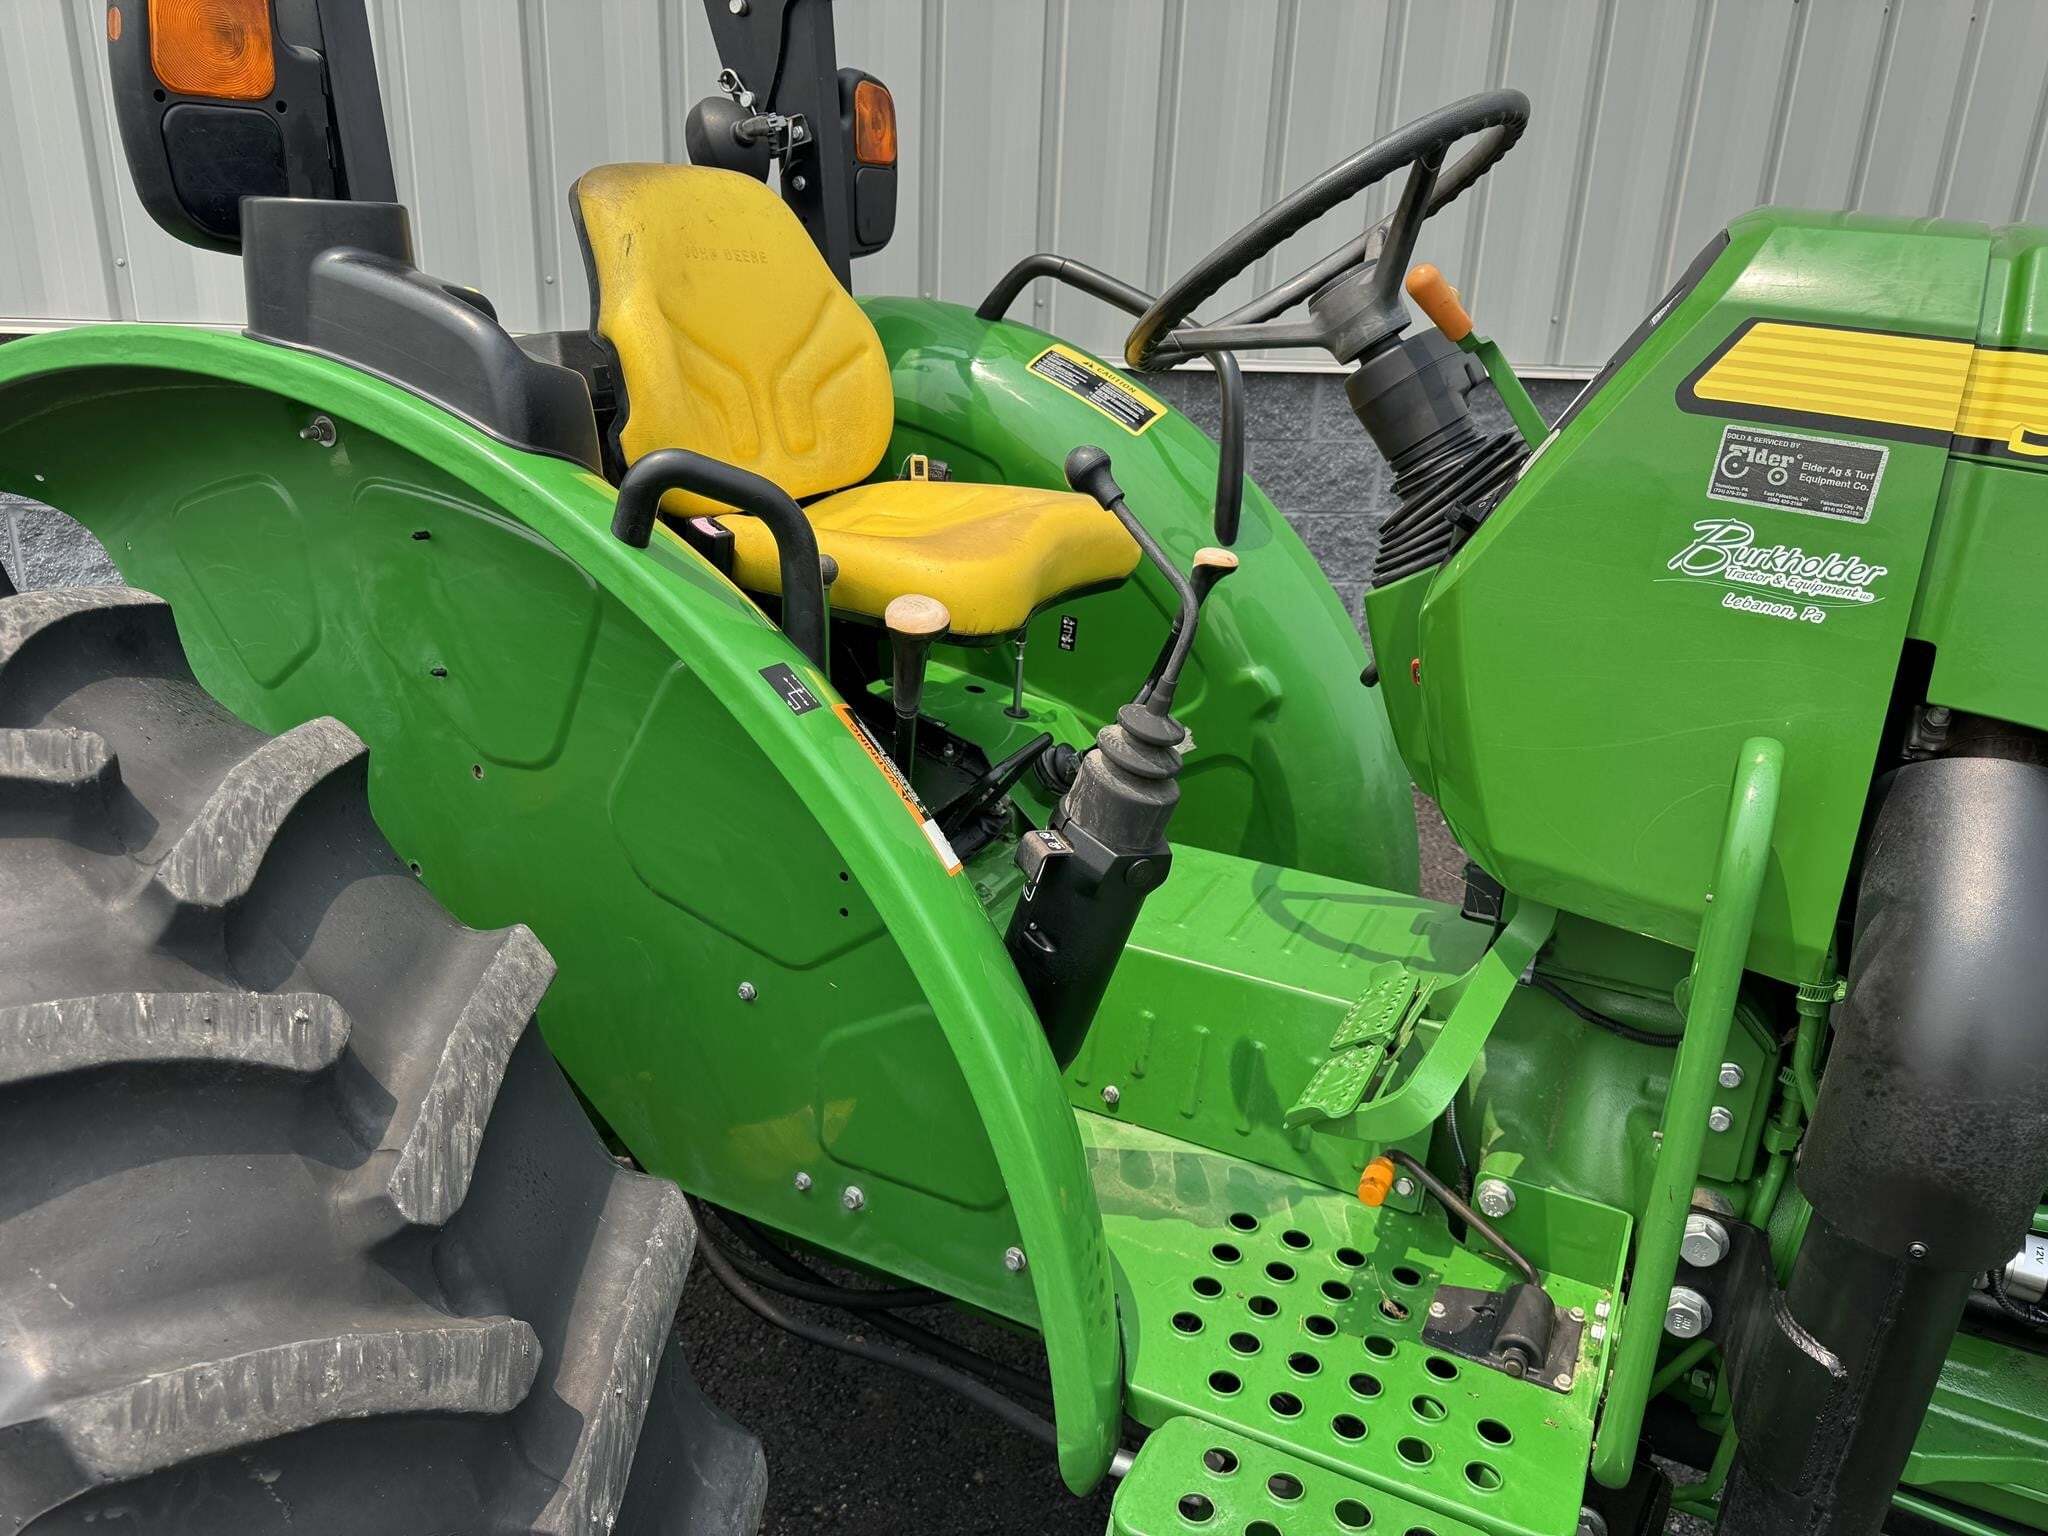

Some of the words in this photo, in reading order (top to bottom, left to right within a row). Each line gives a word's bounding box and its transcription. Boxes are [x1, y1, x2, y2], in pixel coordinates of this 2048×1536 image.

[1097, 367, 1136, 393] CAUTION
[1727, 432, 1746, 441] SOLD
[1753, 436, 1789, 447] SERVICED
[1721, 444, 1795, 478] Elder
[1801, 462, 1828, 474] Elder
[1828, 466, 1843, 478] Ag
[1844, 469, 1852, 477] &
[1854, 469, 1876, 480] Turf
[1799, 473, 1851, 489] Equipment
[1853, 481, 1870, 492] Co.
[1667, 518, 1888, 585] Burkholder
[1725, 565, 1772, 584] Tractor
[1773, 573, 1784, 586] &
[1785, 575, 1860, 598] Equipment
[1722, 592, 1797, 619] Lebanon,
[1801, 605, 1825, 623] Pa
[850, 723, 899, 788] WARNING
[2035, 1246, 2045, 1265] 12V
